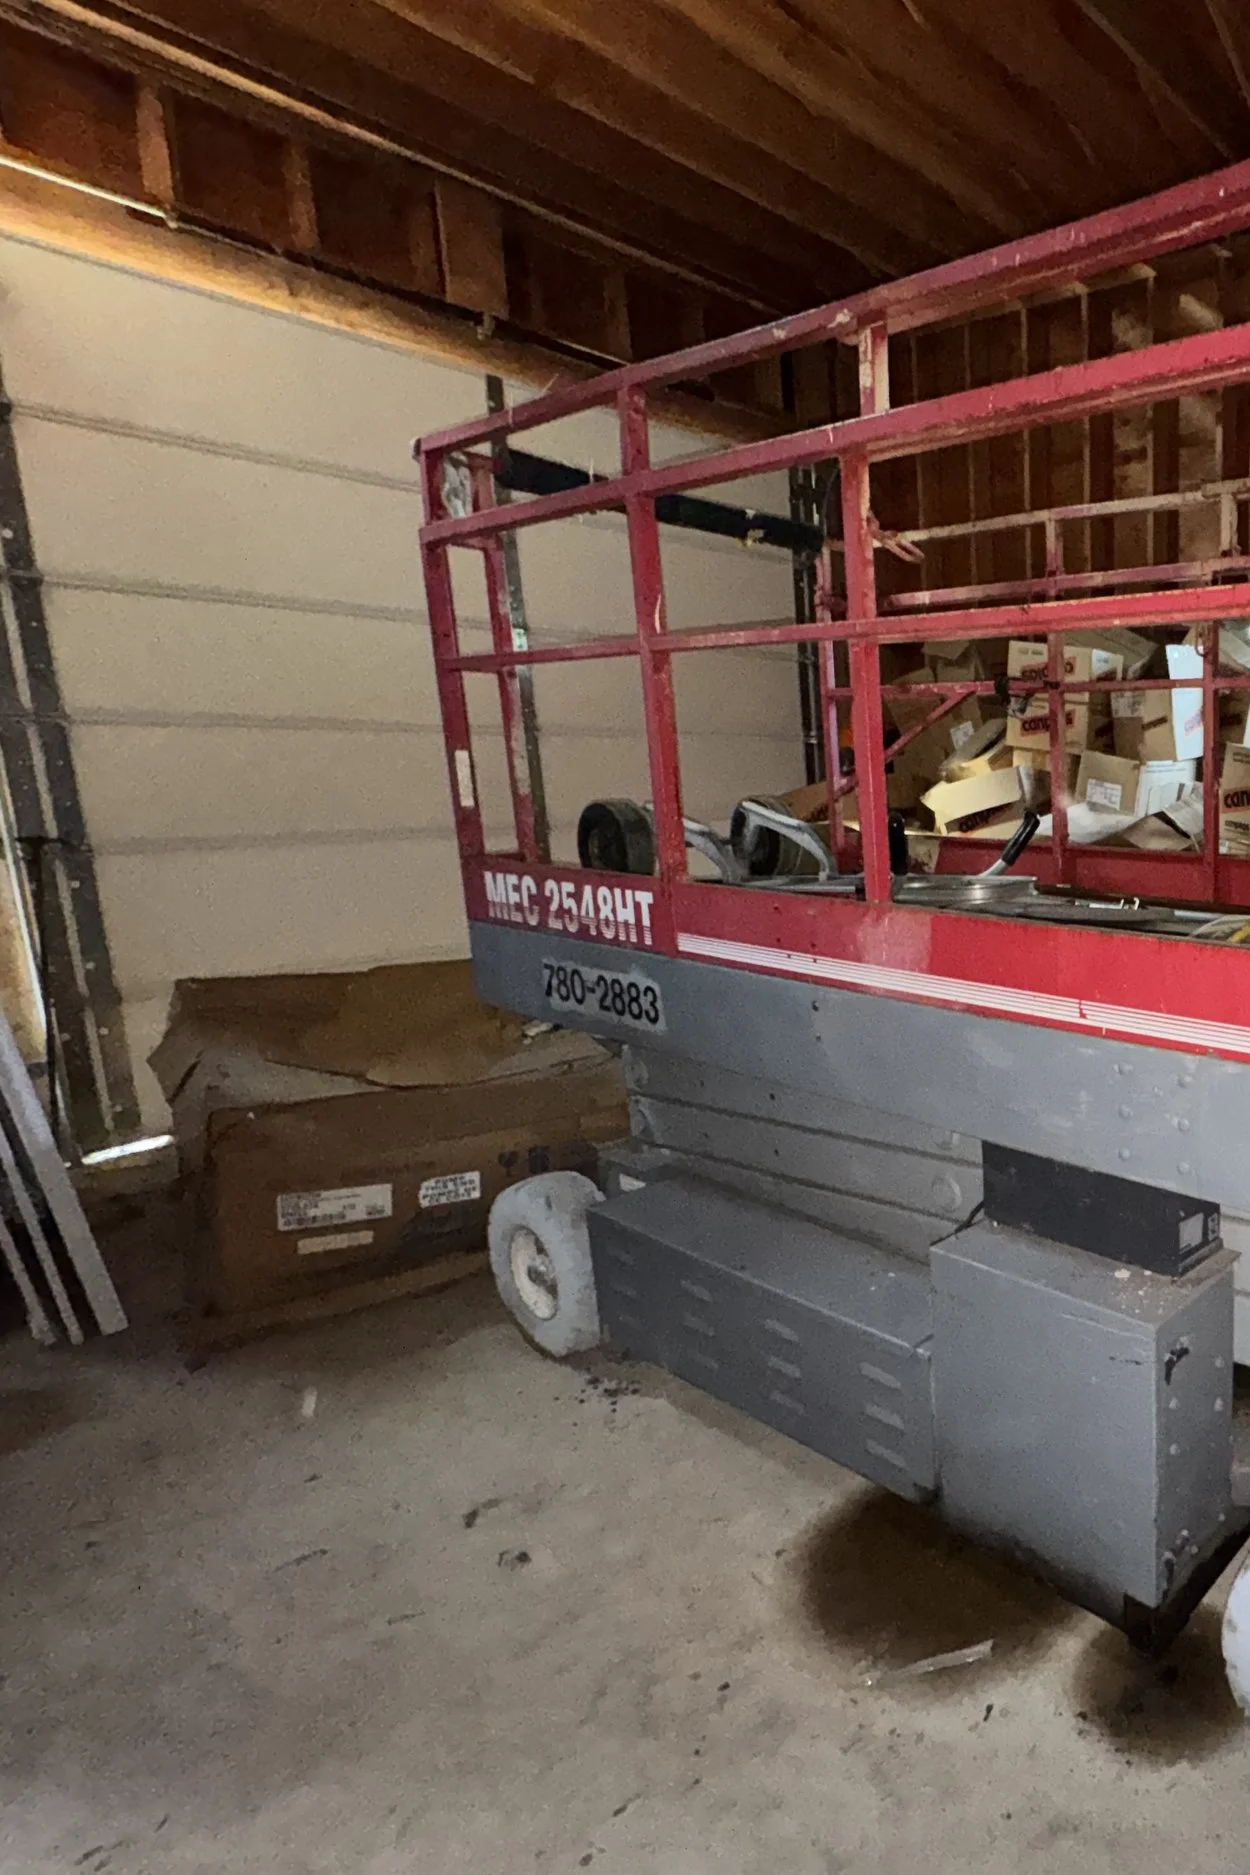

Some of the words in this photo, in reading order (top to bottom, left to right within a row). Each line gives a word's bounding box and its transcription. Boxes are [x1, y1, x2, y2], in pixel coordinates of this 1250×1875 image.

[483, 870, 540, 927] MEC
[544, 879, 654, 945] 2548HT
[543, 963, 660, 1025] 780-2883
